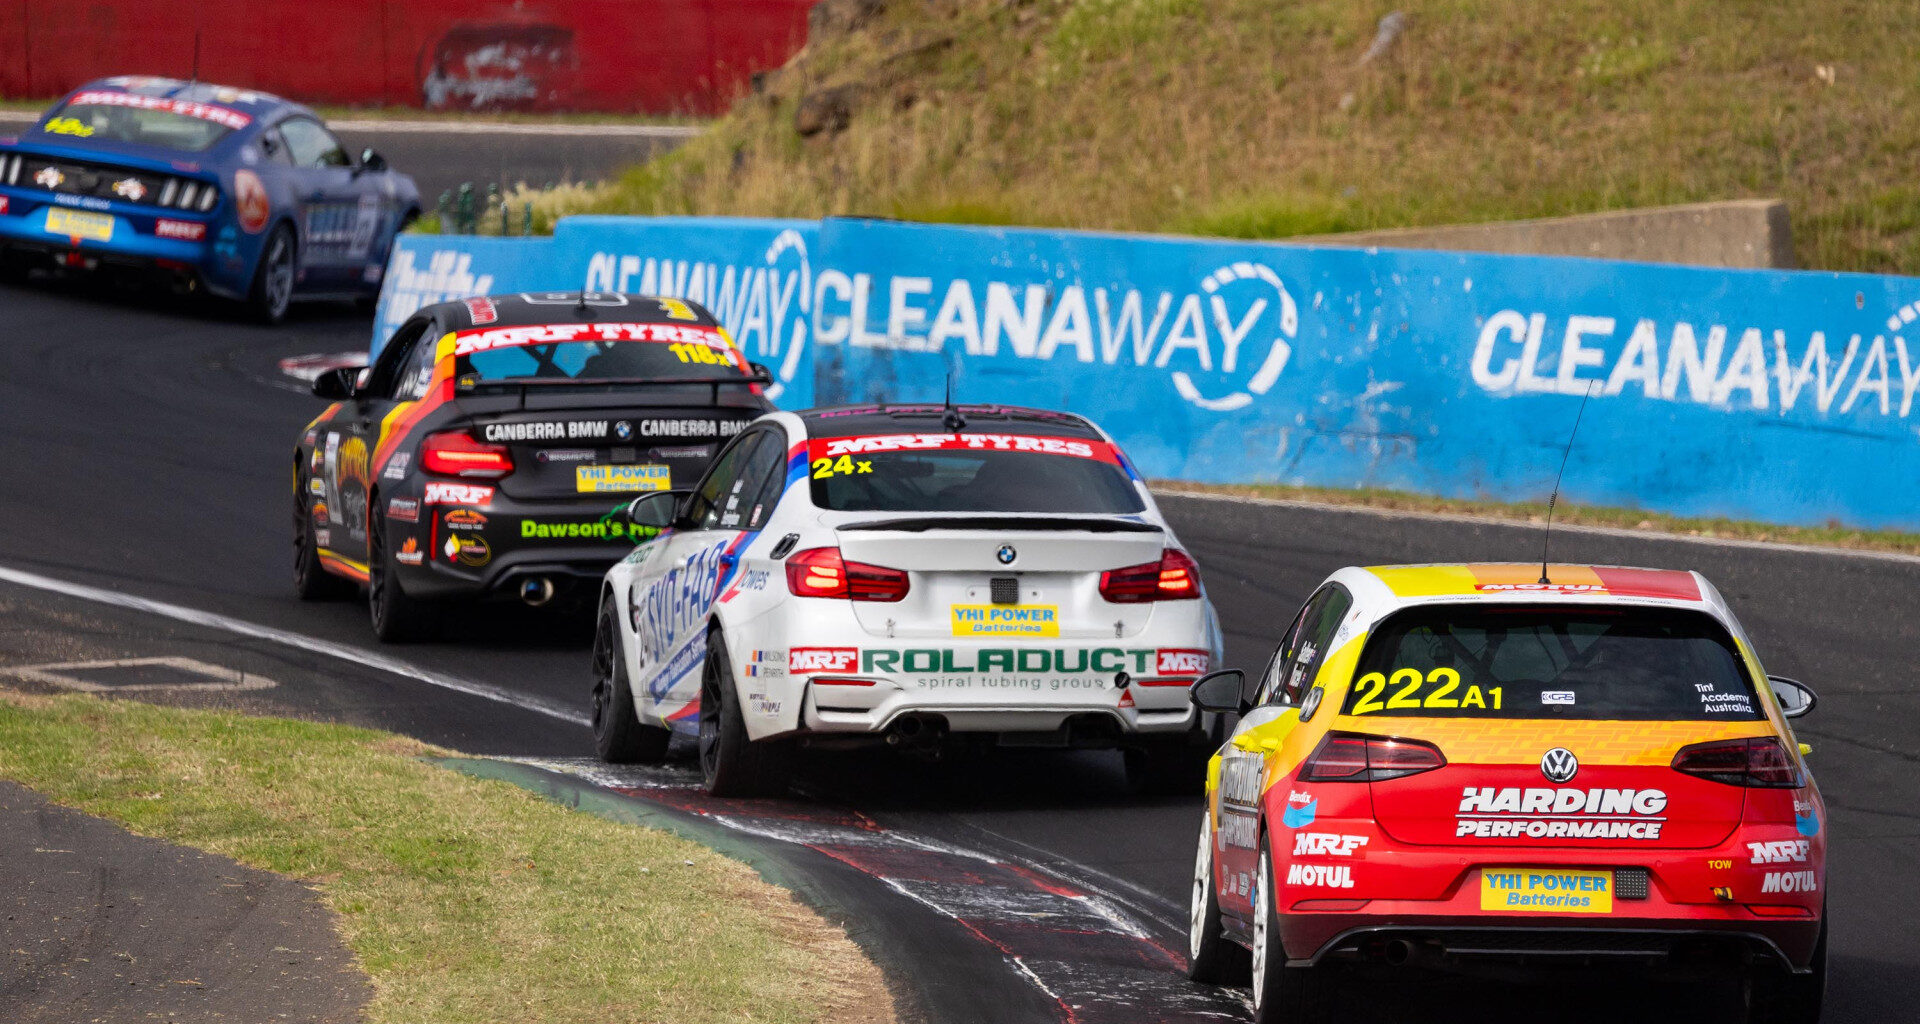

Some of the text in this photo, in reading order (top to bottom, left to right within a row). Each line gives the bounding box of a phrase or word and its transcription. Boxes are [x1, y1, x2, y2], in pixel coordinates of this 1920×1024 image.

[814, 269, 1267, 373] CLEANAWAY
[455, 323, 731, 356] MRF TYRES
[485, 420, 608, 441] CANBERRA BMW
[640, 419, 718, 437] CANBERRA
[827, 434, 1094, 457] MRF TYRES
[579, 467, 669, 479] YHI POWER
[812, 455, 873, 480] 24x
[425, 483, 492, 504] MRF
[520, 519, 623, 537] Dawson's
[954, 609, 1054, 622] YHI POWER
[972, 623, 1042, 633] Batteries
[789, 650, 857, 670] MRF
[862, 648, 1156, 673] ROLADUCT
[917, 675, 972, 690] spiral
[981, 675, 1041, 691] tubing
[1695, 683, 1714, 693] Tint
[1701, 693, 1750, 704] Academy
[1458, 787, 1668, 815] HARDING
[1456, 820, 1663, 840] PERFORMANCE
[1293, 833, 1369, 857] MRF
[1747, 840, 1810, 864] MRF
[1708, 860, 1732, 870] TOW
[1287, 864, 1355, 888] MOTUL
[1486, 873, 1607, 892] YHI POWER
[1761, 871, 1816, 893] MOTUL
[1506, 892, 1591, 907] Batteries
